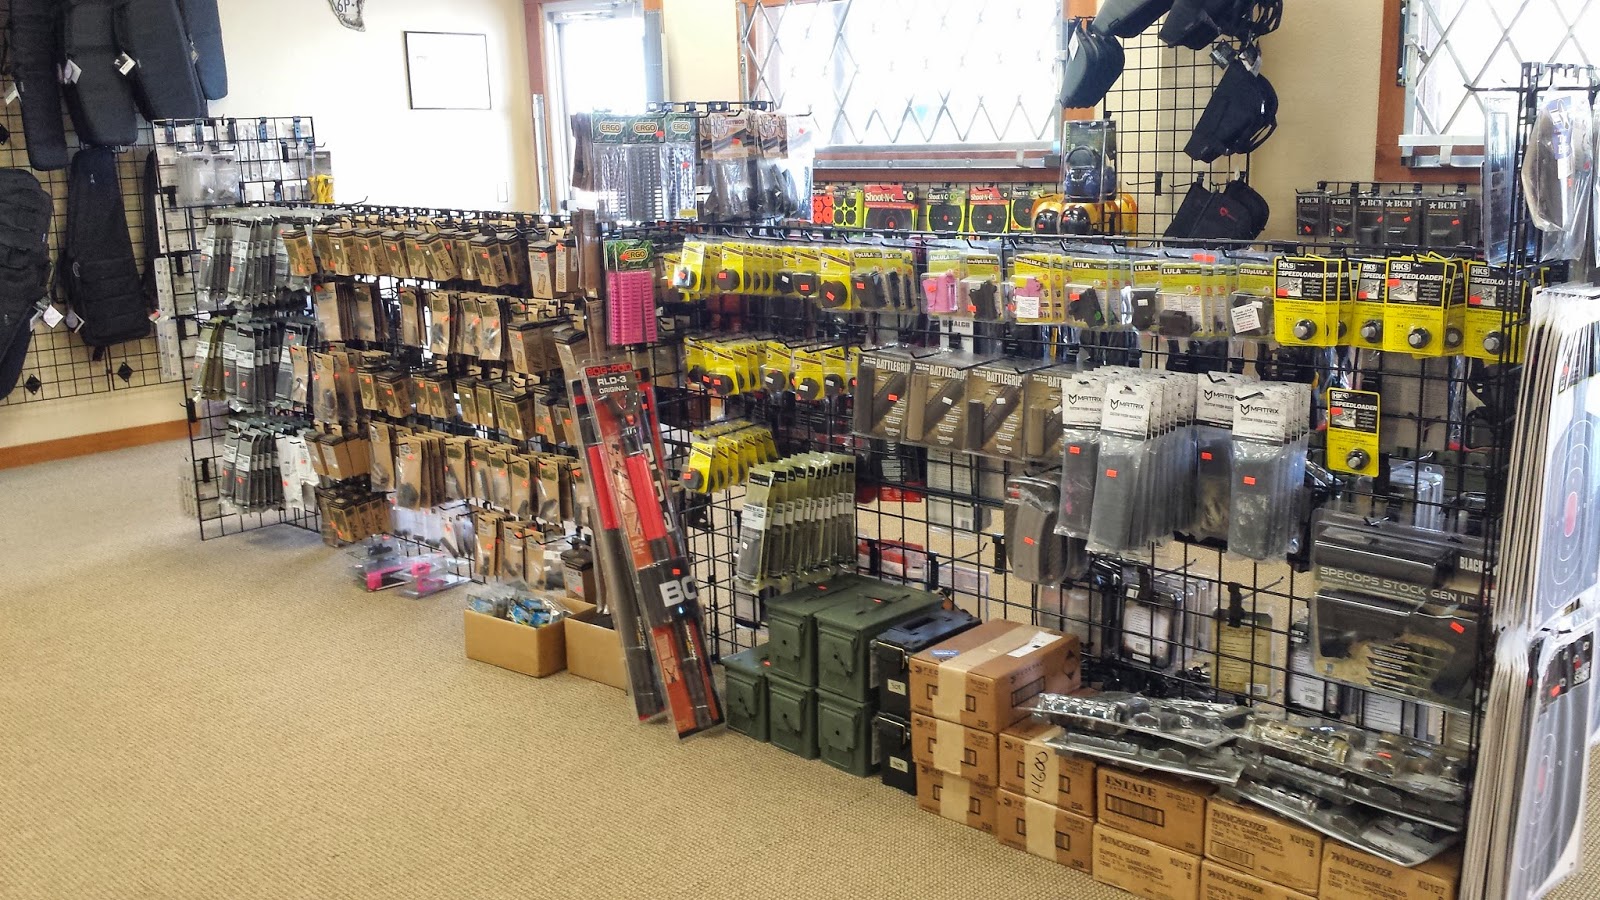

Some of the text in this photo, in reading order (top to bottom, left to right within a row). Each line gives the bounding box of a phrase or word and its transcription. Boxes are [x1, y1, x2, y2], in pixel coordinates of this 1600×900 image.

[1394, 199, 1413, 208] BCM
[1437, 201, 1457, 210] BCM
[1279, 261, 1294, 269] HKS
[1392, 262, 1410, 270] HKS
[1281, 270, 1324, 279] SPEEDLOADER
[1393, 272, 1444, 281] SPEEDLOADER
[1472, 267, 1488, 275] HKS
[586, 363, 632, 377] BOG-POD
[876, 358, 911, 374] BATTLEGRIP
[596, 375, 627, 386] RLD-3
[986, 370, 1023, 387] BATTLEGRIP
[598, 385, 630, 394] ORIGINAL
[1250, 406, 1279, 415] MATRIX
[1335, 401, 1378, 411] SPEEDLOADER
[1320, 566, 1380, 586] SPECOPS
[1382, 579, 1427, 596] STOCK
[1430, 589, 1457, 602] GEN
[1031, 751, 1049, 794] 4600
[1105, 775, 1157, 797] ESTATE
[1212, 809, 1268, 833] WINCHESTER
[1099, 833, 1151, 857] WINCHESTER
[1331, 851, 1393, 879] WINCHESTER
[1207, 869, 1264, 895] WINCHESTER
